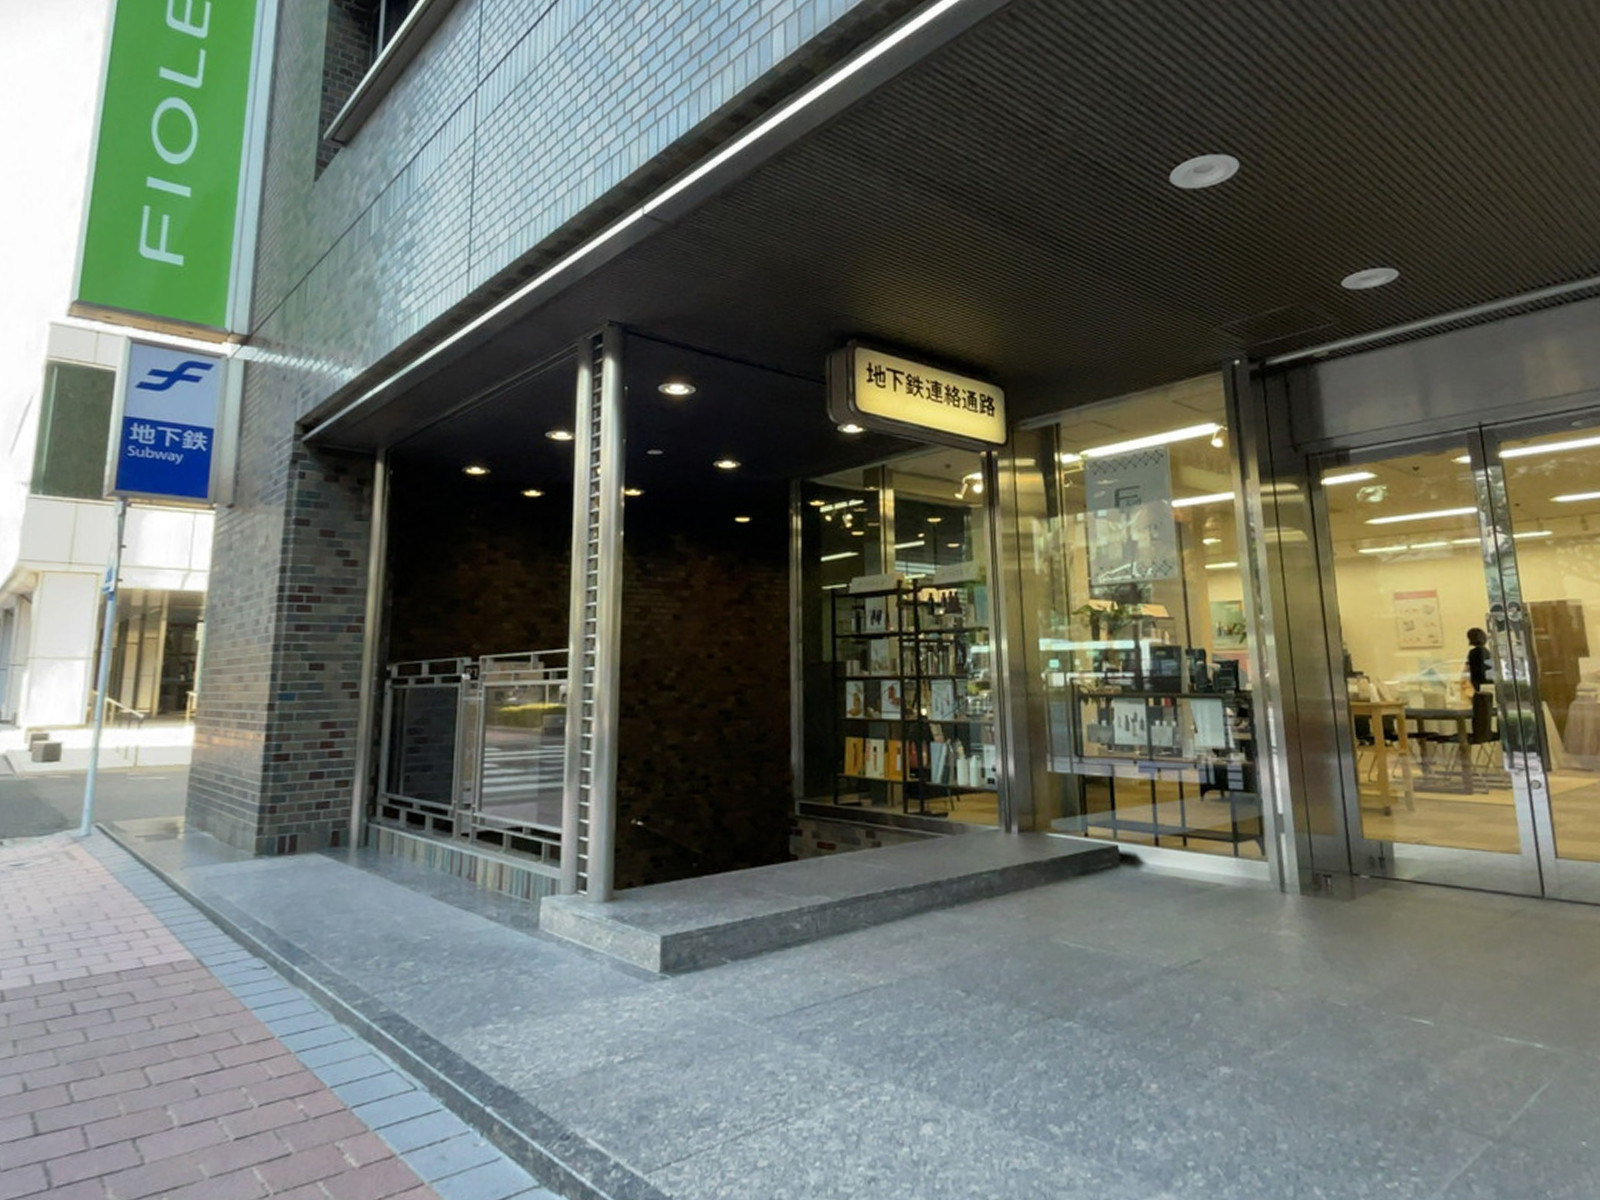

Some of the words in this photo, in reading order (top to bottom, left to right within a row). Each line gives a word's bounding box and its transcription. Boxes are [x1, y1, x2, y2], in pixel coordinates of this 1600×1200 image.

[140, 0, 211, 266] FIOLE
[866, 362, 996, 417] 地下鉄連絡通路
[127, 445, 184, 465] Subway
[128, 422, 208, 451] 地下鉄
